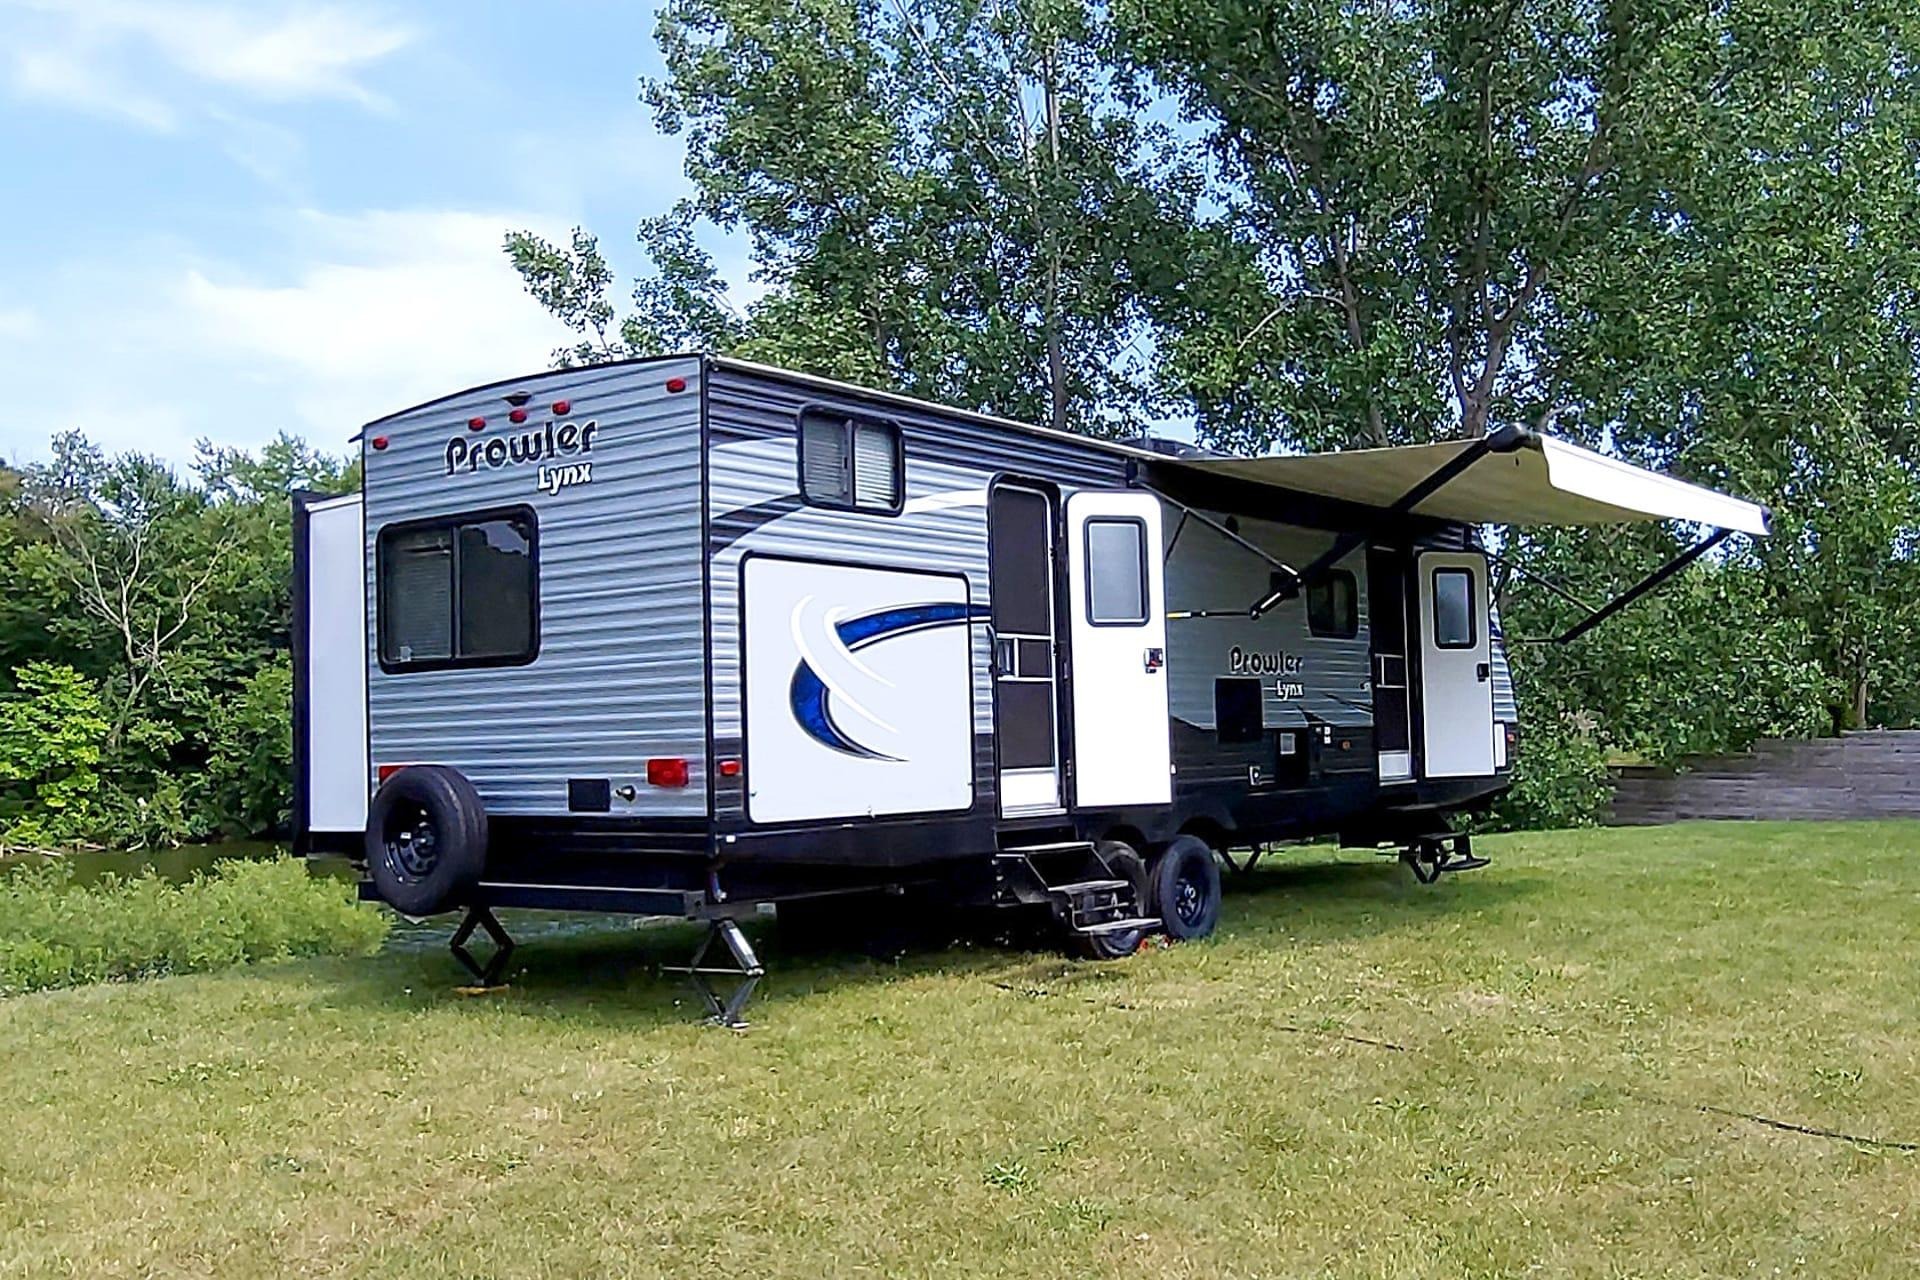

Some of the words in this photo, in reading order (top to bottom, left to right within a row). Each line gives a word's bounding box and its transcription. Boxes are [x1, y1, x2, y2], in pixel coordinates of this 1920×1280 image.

[446, 421, 596, 476] Prowler
[538, 463, 592, 495] Lynx
[1229, 646, 1303, 674] Prowler
[1277, 679, 1304, 702] Lynx
